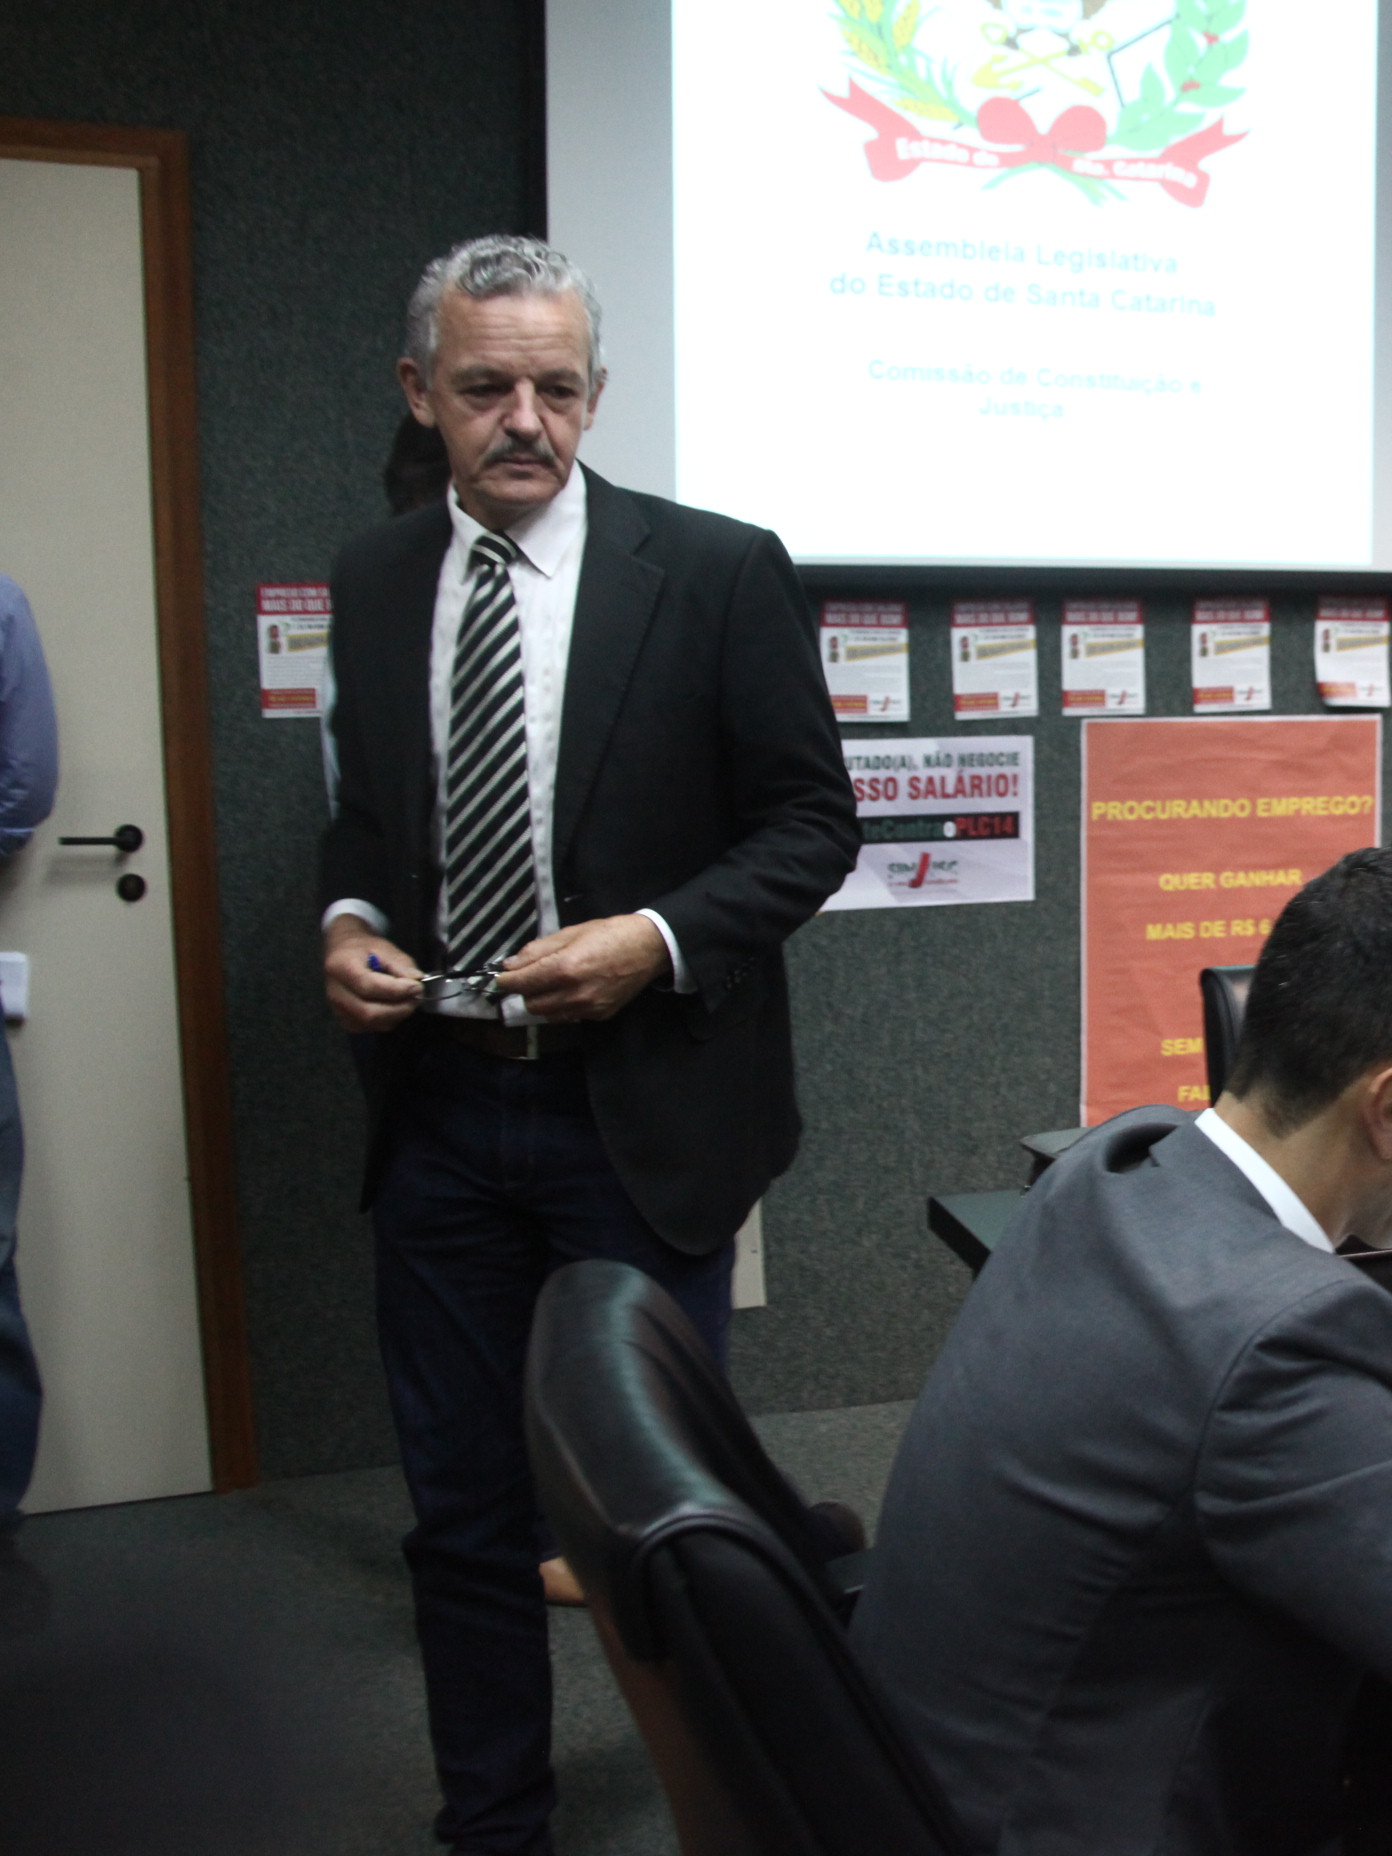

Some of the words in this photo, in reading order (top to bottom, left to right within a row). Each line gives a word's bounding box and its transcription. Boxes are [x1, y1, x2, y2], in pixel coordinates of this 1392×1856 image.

[866, 231, 1026, 264] Assembleia
[1037, 243, 1178, 275] Legislativa
[829, 273, 866, 297] do
[878, 274, 973, 303] Estado
[984, 280, 1016, 305] de
[1027, 283, 1101, 311] Santa
[1111, 289, 1217, 318] Catarina
[868, 359, 991, 386] Comissão
[1000, 364, 1028, 387] de
[1036, 367, 1183, 397] Constituição
[1190, 379, 1202, 394] e
[978, 398, 1064, 422] Justiça
[923, 751, 954, 768] NÃO
[957, 752, 1020, 768] NEGOCIE
[853, 776, 898, 802] SSO
[908, 769, 1019, 801] SALÁRIO!
[1091, 799, 1251, 821] PROCURANDO
[1256, 795, 1375, 818] EMPREGO?
[1159, 872, 1215, 892] QUER
[1219, 869, 1303, 889] GANHAR
[1146, 921, 1195, 940] MAIS
[1199, 919, 1227, 938] DE
[1231, 918, 1256, 937] R$
[1161, 1037, 1204, 1057] SEM
